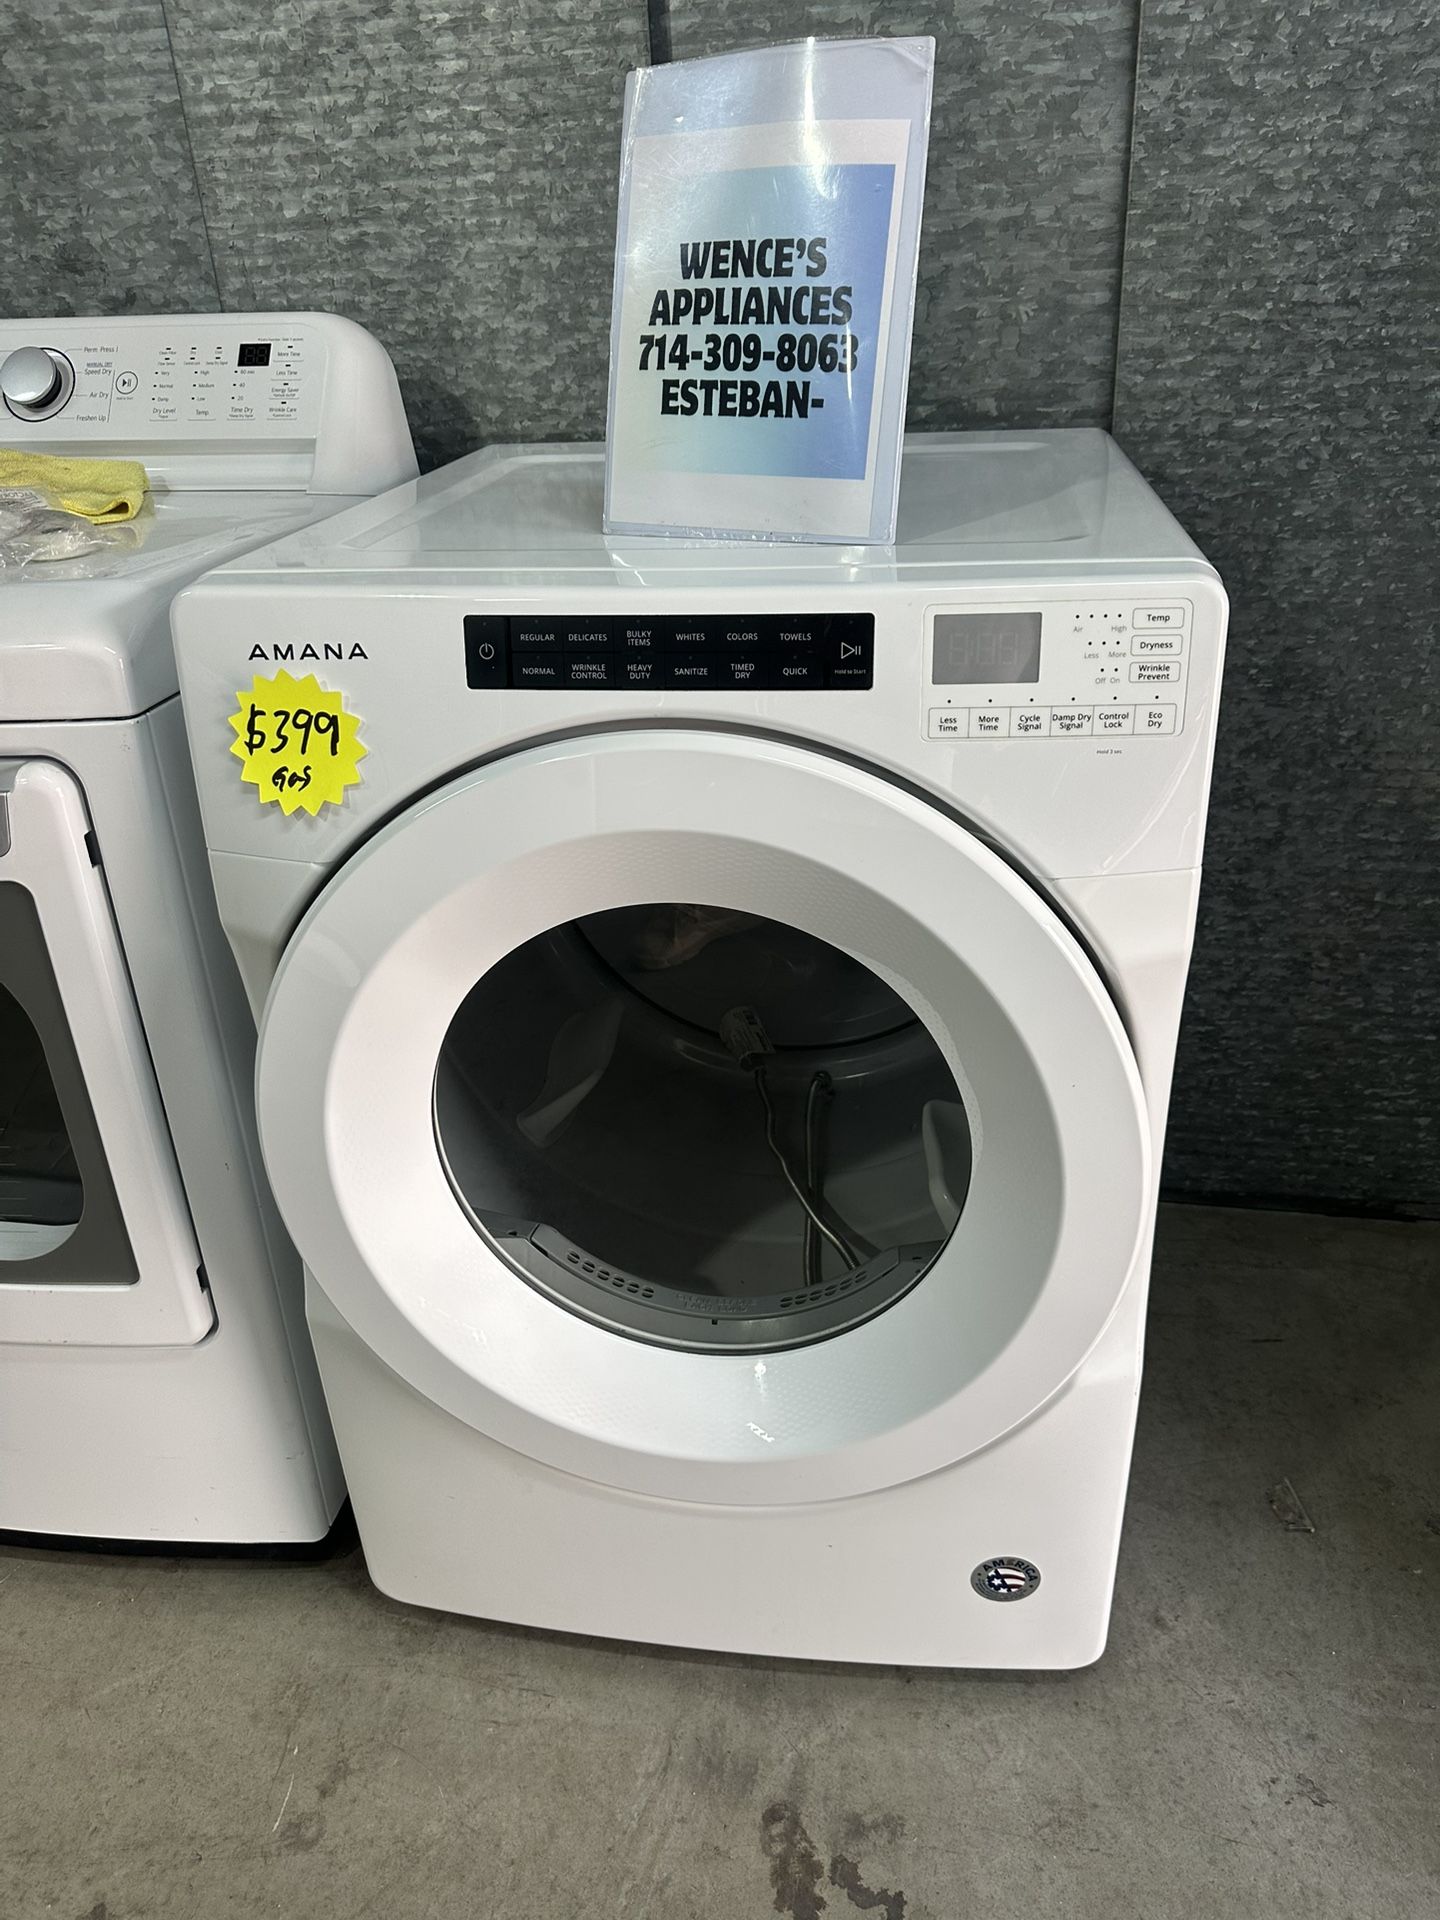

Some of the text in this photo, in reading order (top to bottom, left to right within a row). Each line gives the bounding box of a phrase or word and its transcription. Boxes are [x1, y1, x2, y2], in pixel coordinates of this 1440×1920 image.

[679, 237, 828, 280] WENCE'S
[648, 285, 853, 327] APPLIANCES
[638, 333, 859, 373] 714-309-8063
[84, 368, 112, 376] Speed Dry
[99, 391, 109, 399] Dry
[660, 378, 825, 419] ESTEBAN-
[1146, 613, 1171, 623] Temp
[626, 630, 652, 638] BULKY
[1111, 625, 1128, 634] High
[520, 633, 556, 642] REGULAR
[568, 633, 608, 642] DELICATES
[675, 632, 706, 641] WHITES
[726, 632, 759, 641] COLORS
[779, 632, 812, 641] TOWELS
[627, 638, 651, 647] ITEMS
[1139, 641, 1174, 651] Dryness
[248, 642, 369, 661] AMANA
[522, 667, 556, 675] NORMAL
[571, 663, 607, 671] WRINKLE
[627, 664, 653, 672] HEAVY
[674, 667, 709, 676] SANITIZE
[730, 663, 755, 671] TIMED
[782, 667, 808, 676] QUICK
[1138, 663, 1171, 672] Wrinkle
[571, 671, 608, 680] CONTROL
[629, 671, 651, 680] DUTY
[734, 671, 751, 679] DRY
[1137, 672, 1170, 681] Prevent
[978, 715, 1000, 723] More
[1019, 714, 1041, 724] Cycle
[1052, 713, 1092, 723] Damp Dry
[1098, 712, 1130, 720] Control
[1148, 711, 1163, 719] Eco
[939, 716, 957, 724] Less
[1103, 720, 1123, 729] Lock
[1147, 720, 1163, 728] Dry
[243, 702, 341, 757] $399
[938, 724, 958, 732] Time
[979, 723, 999, 731] Time
[1017, 722, 1042, 732] Signal
[1059, 721, 1084, 731] Signal
